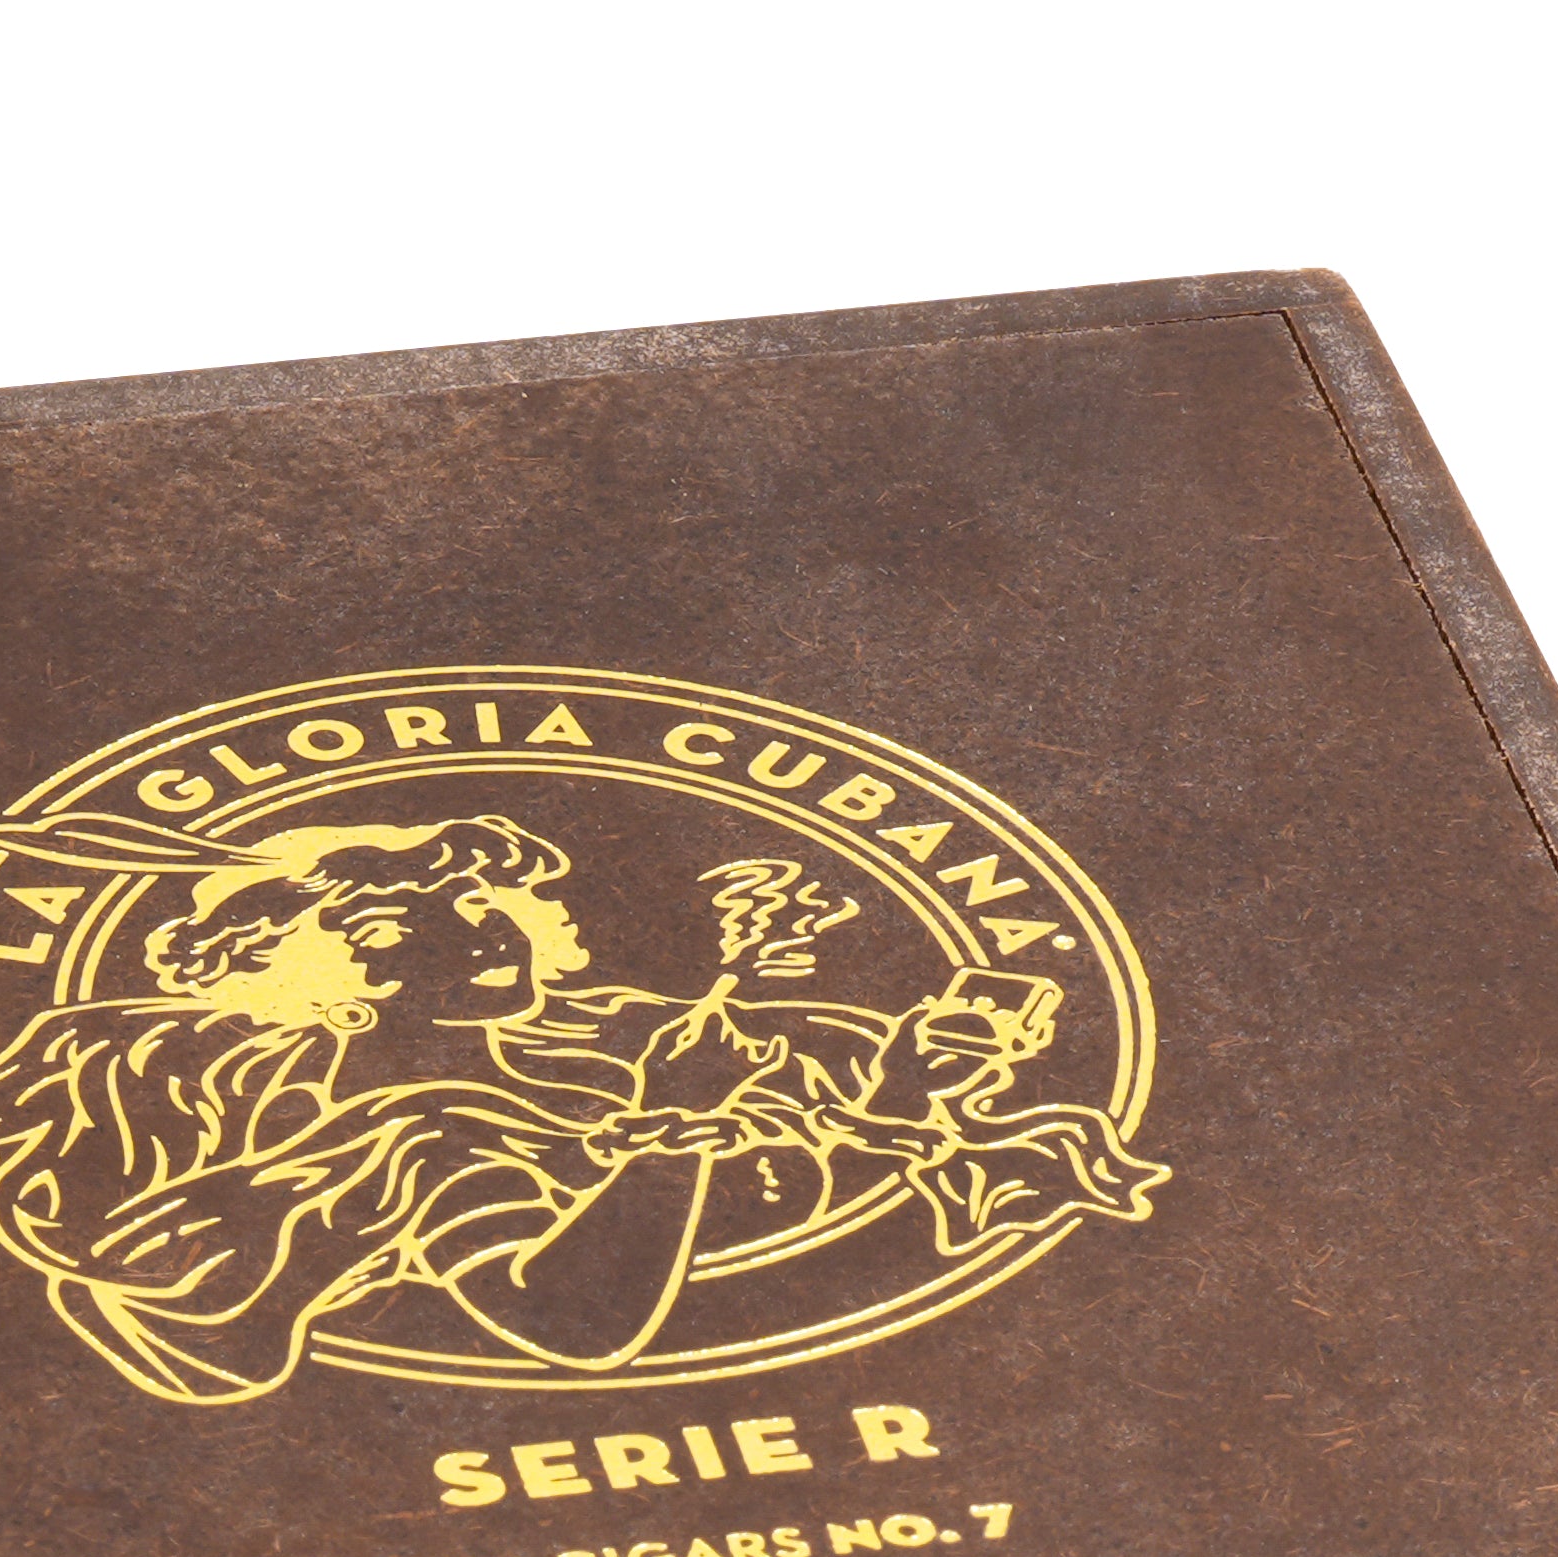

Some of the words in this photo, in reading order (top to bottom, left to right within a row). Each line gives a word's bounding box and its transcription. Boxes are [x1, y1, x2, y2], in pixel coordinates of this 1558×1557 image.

[137, 702, 593, 812] GLORIA
[433, 1416, 814, 1507] SERIE
[851, 1404, 941, 1463] R
